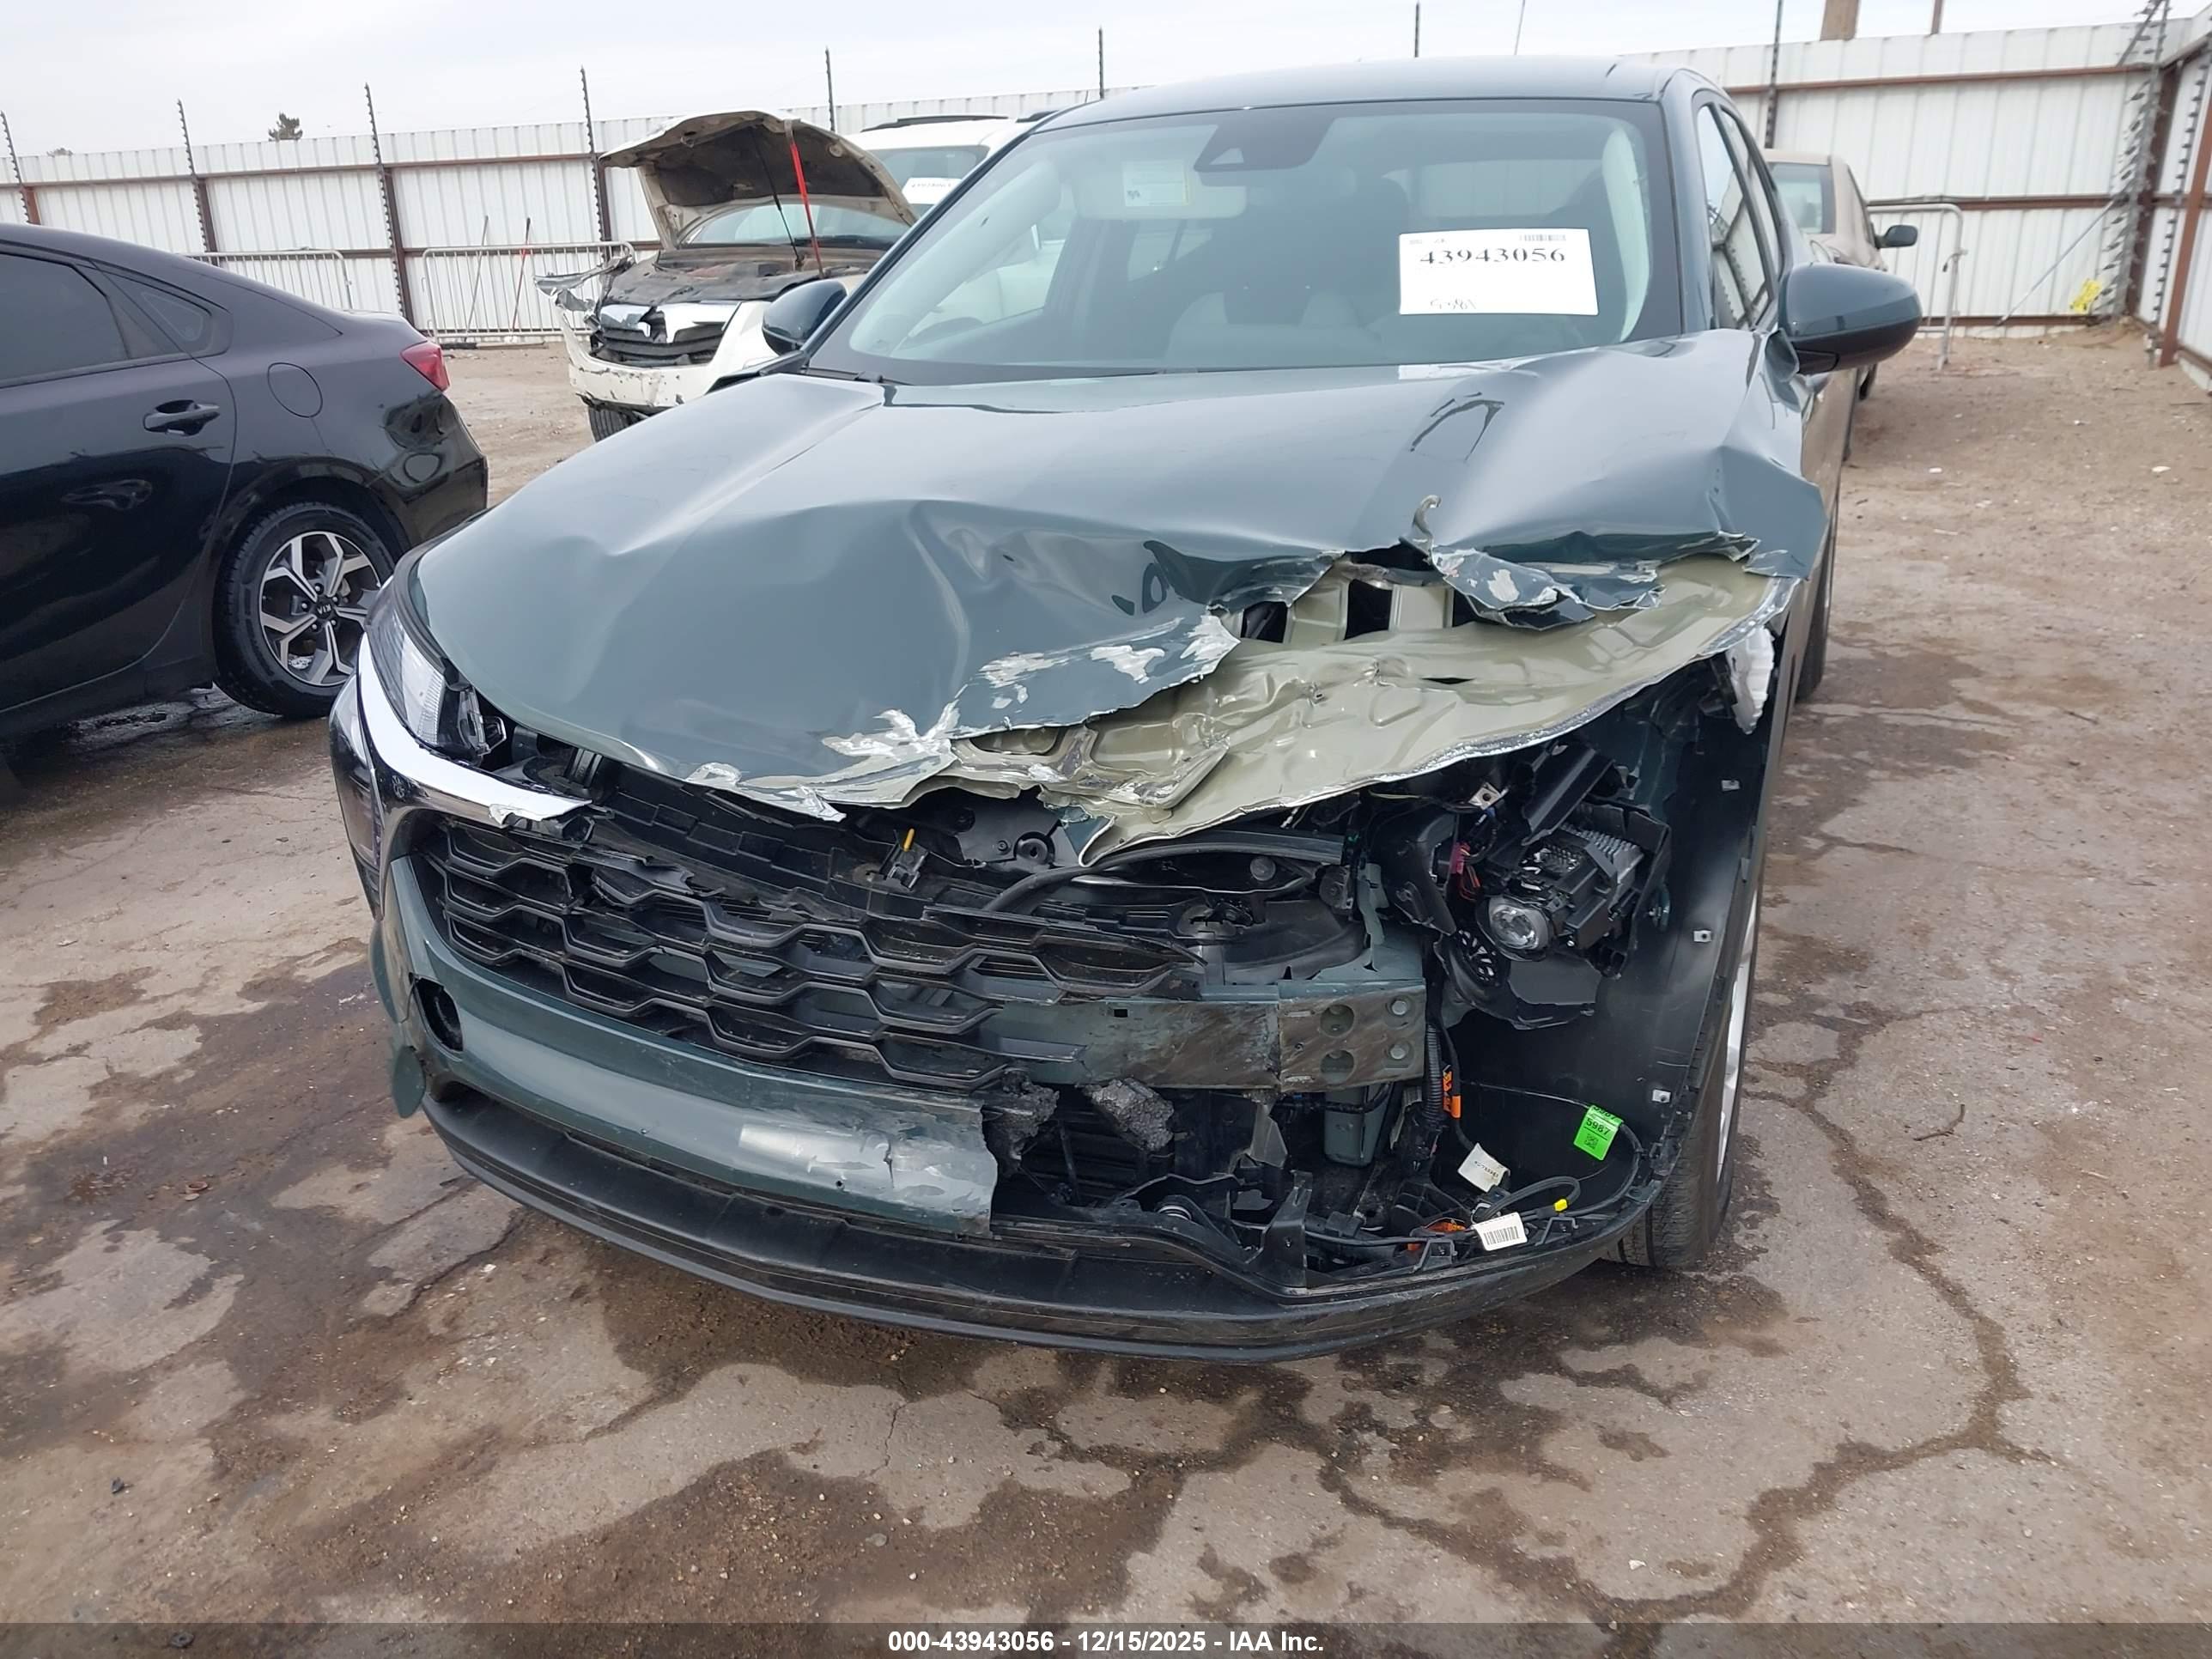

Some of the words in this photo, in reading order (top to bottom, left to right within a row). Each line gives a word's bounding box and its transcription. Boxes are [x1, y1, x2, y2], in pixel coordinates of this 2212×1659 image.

[1419, 247, 1565, 264] 43943056
[317, 604, 331, 614] KIA
[1586, 1117, 1611, 1134] 5987
